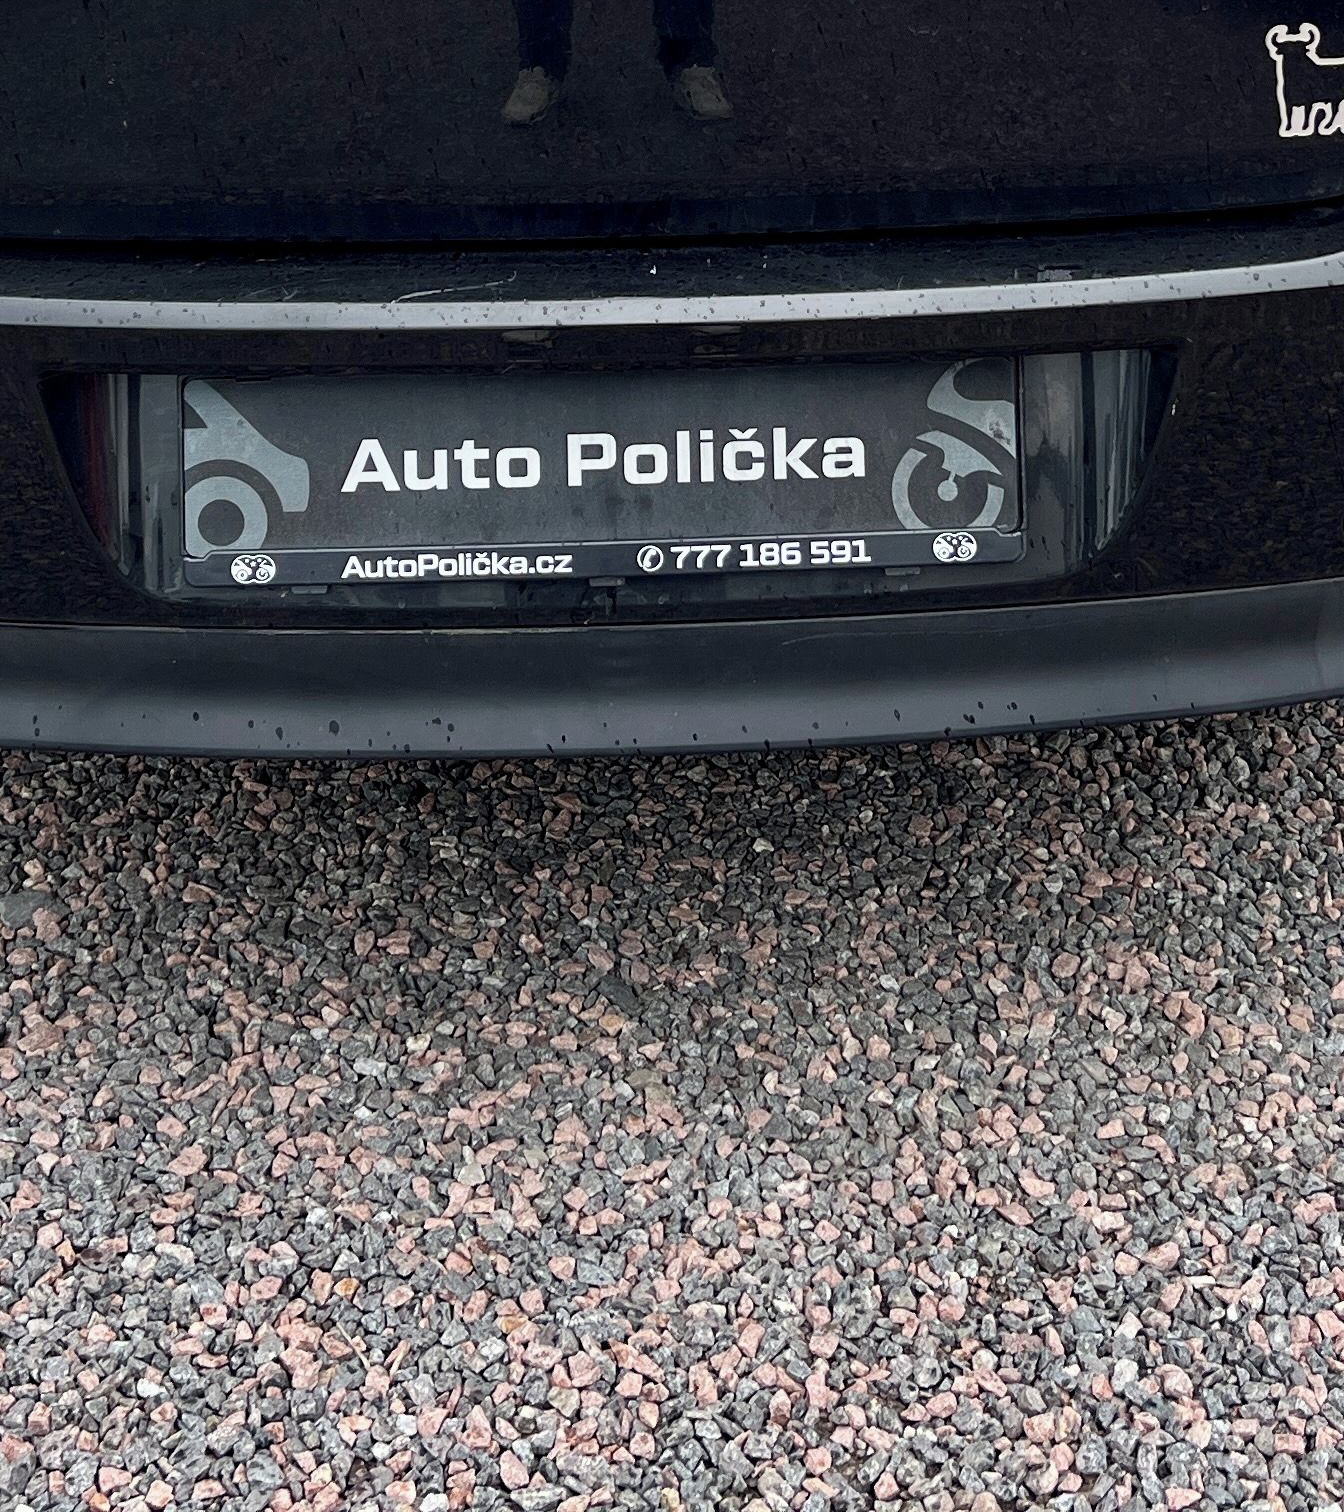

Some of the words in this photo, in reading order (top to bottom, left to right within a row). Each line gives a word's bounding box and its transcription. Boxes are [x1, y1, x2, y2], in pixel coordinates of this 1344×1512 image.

[340, 437, 542, 493] Auto
[566, 426, 867, 488] Polička
[340, 552, 574, 579] AutoPolička.cz
[670, 544, 732, 569] 777
[739, 542, 802, 567] 186
[809, 539, 872, 565] 591
